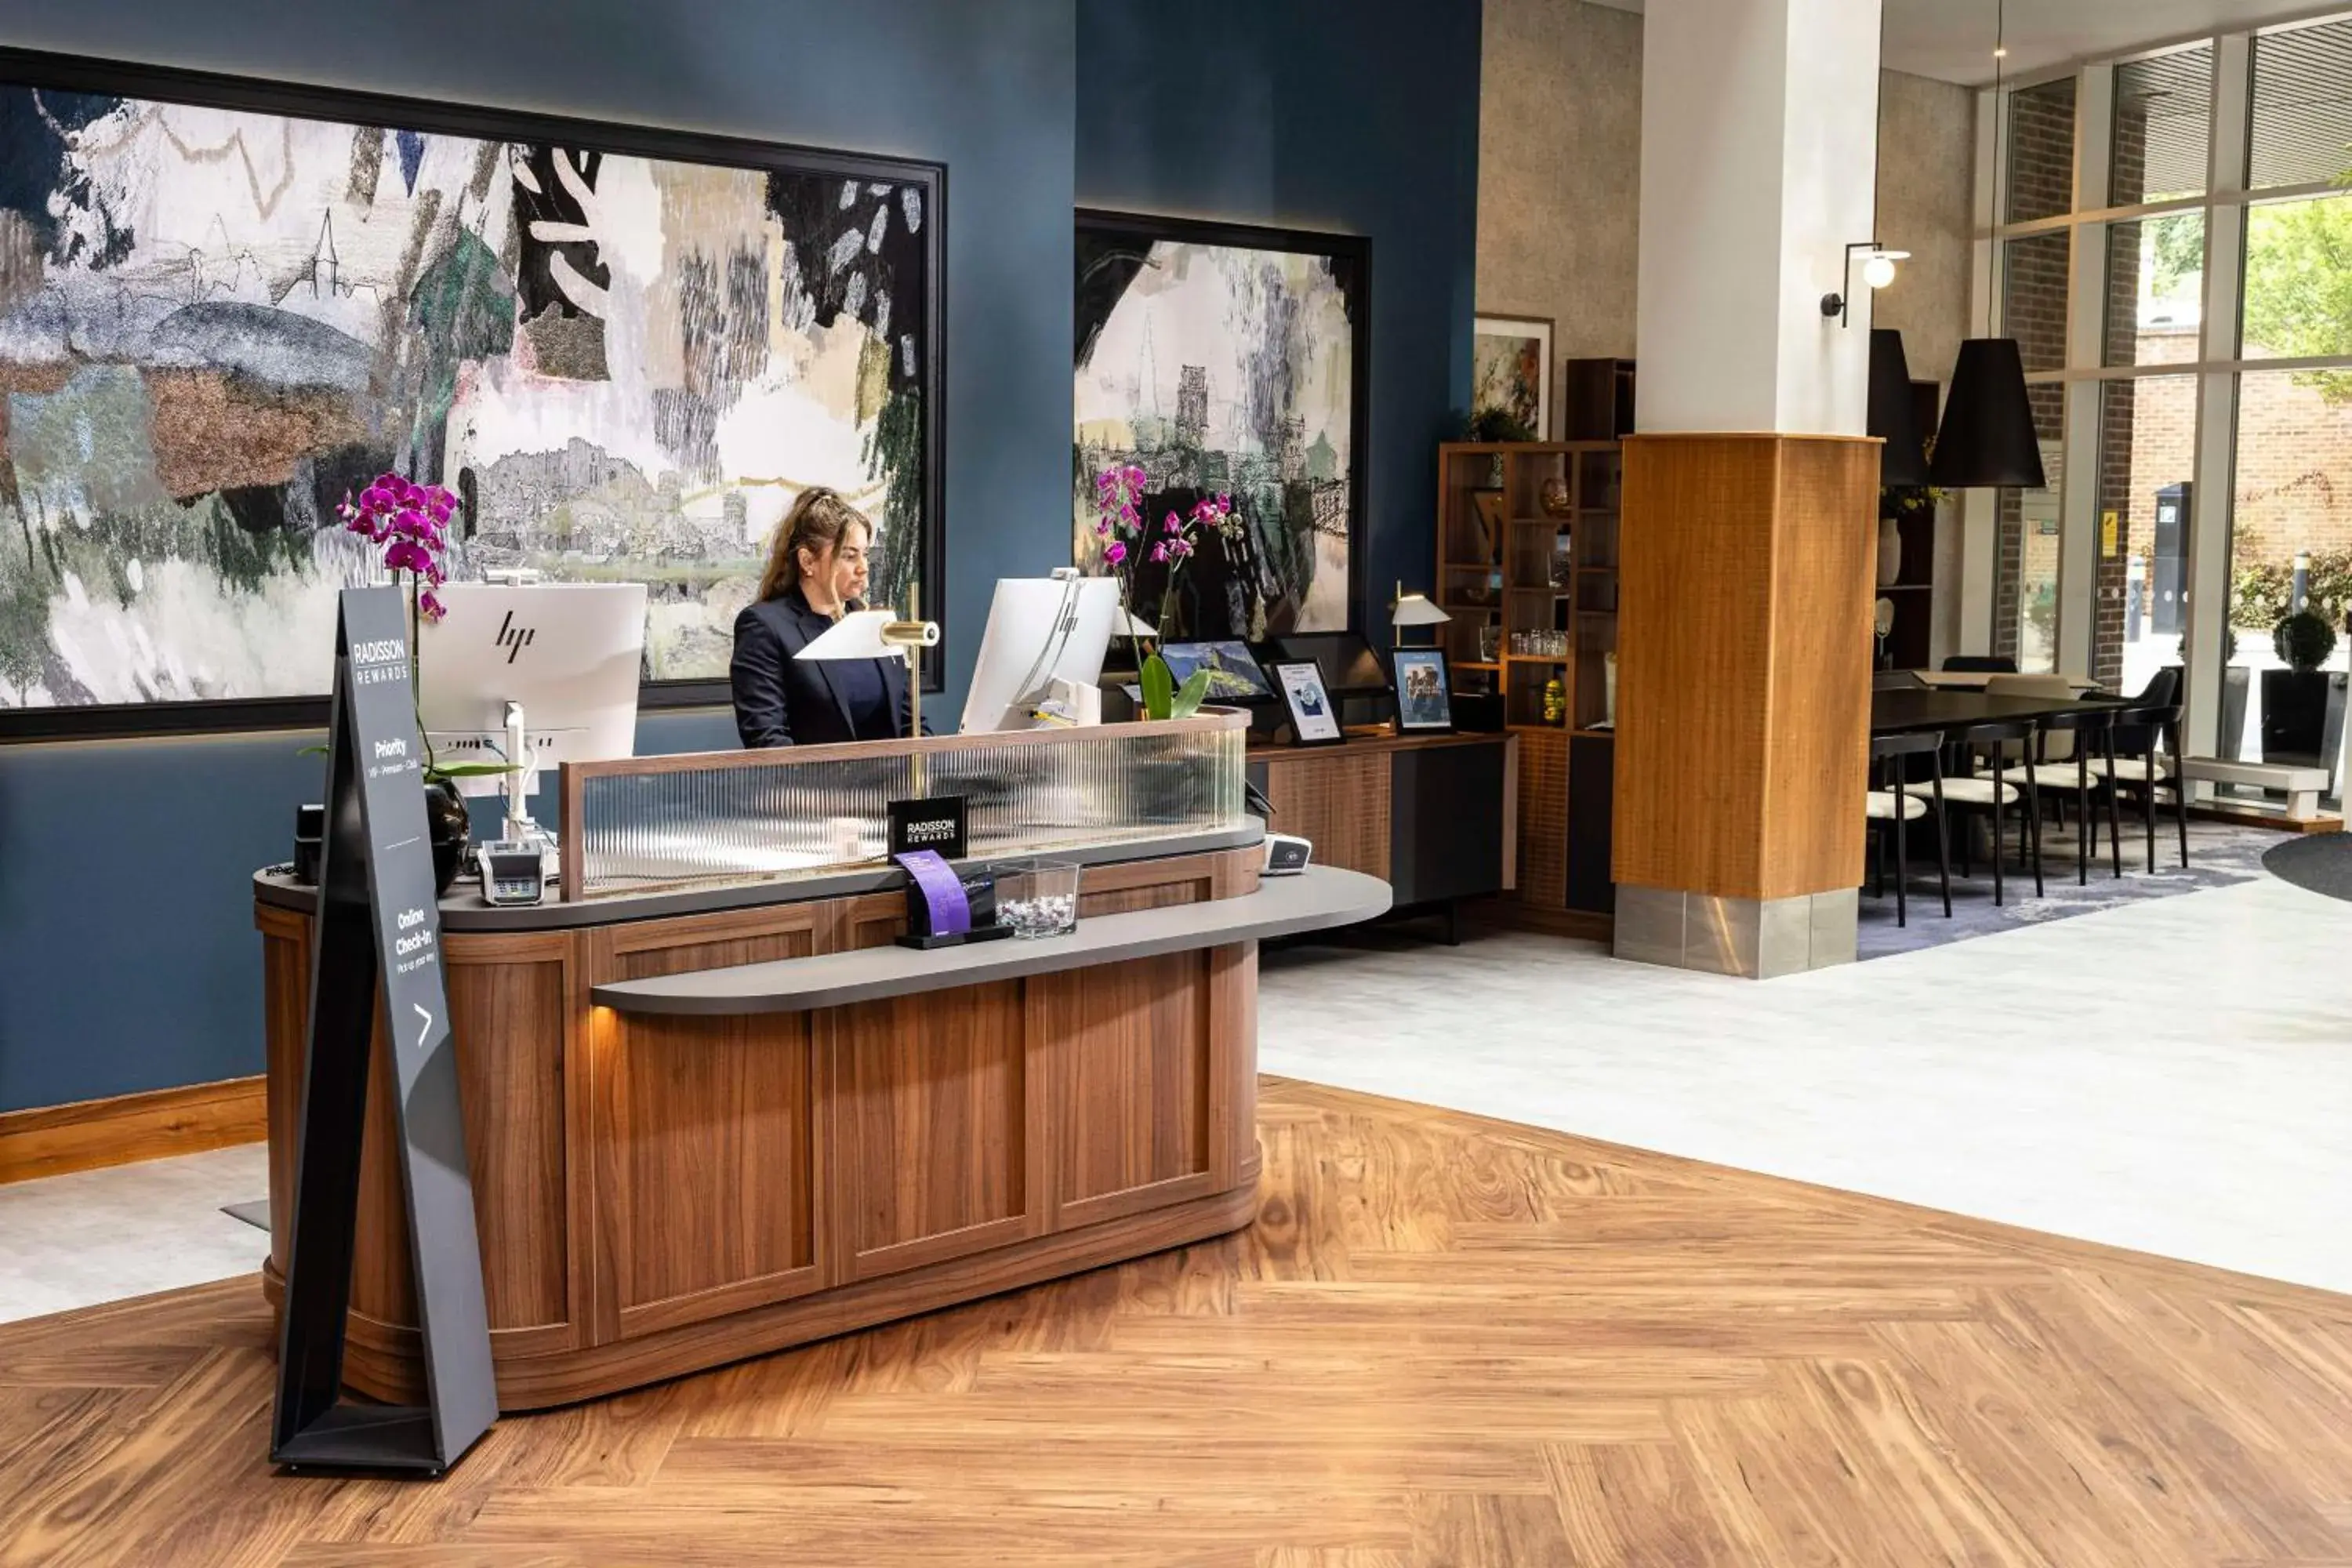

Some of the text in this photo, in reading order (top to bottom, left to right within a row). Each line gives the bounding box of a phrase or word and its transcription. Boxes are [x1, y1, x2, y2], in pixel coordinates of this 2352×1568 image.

[495, 610, 535, 664] hp
[354, 639, 405, 665] RADISSON
[357, 666, 408, 684] REWARDS
[375, 739, 407, 759] Priority
[907, 818, 955, 833] RADISSON
[907, 831, 955, 844] REWARDS
[397, 909, 424, 930] Online
